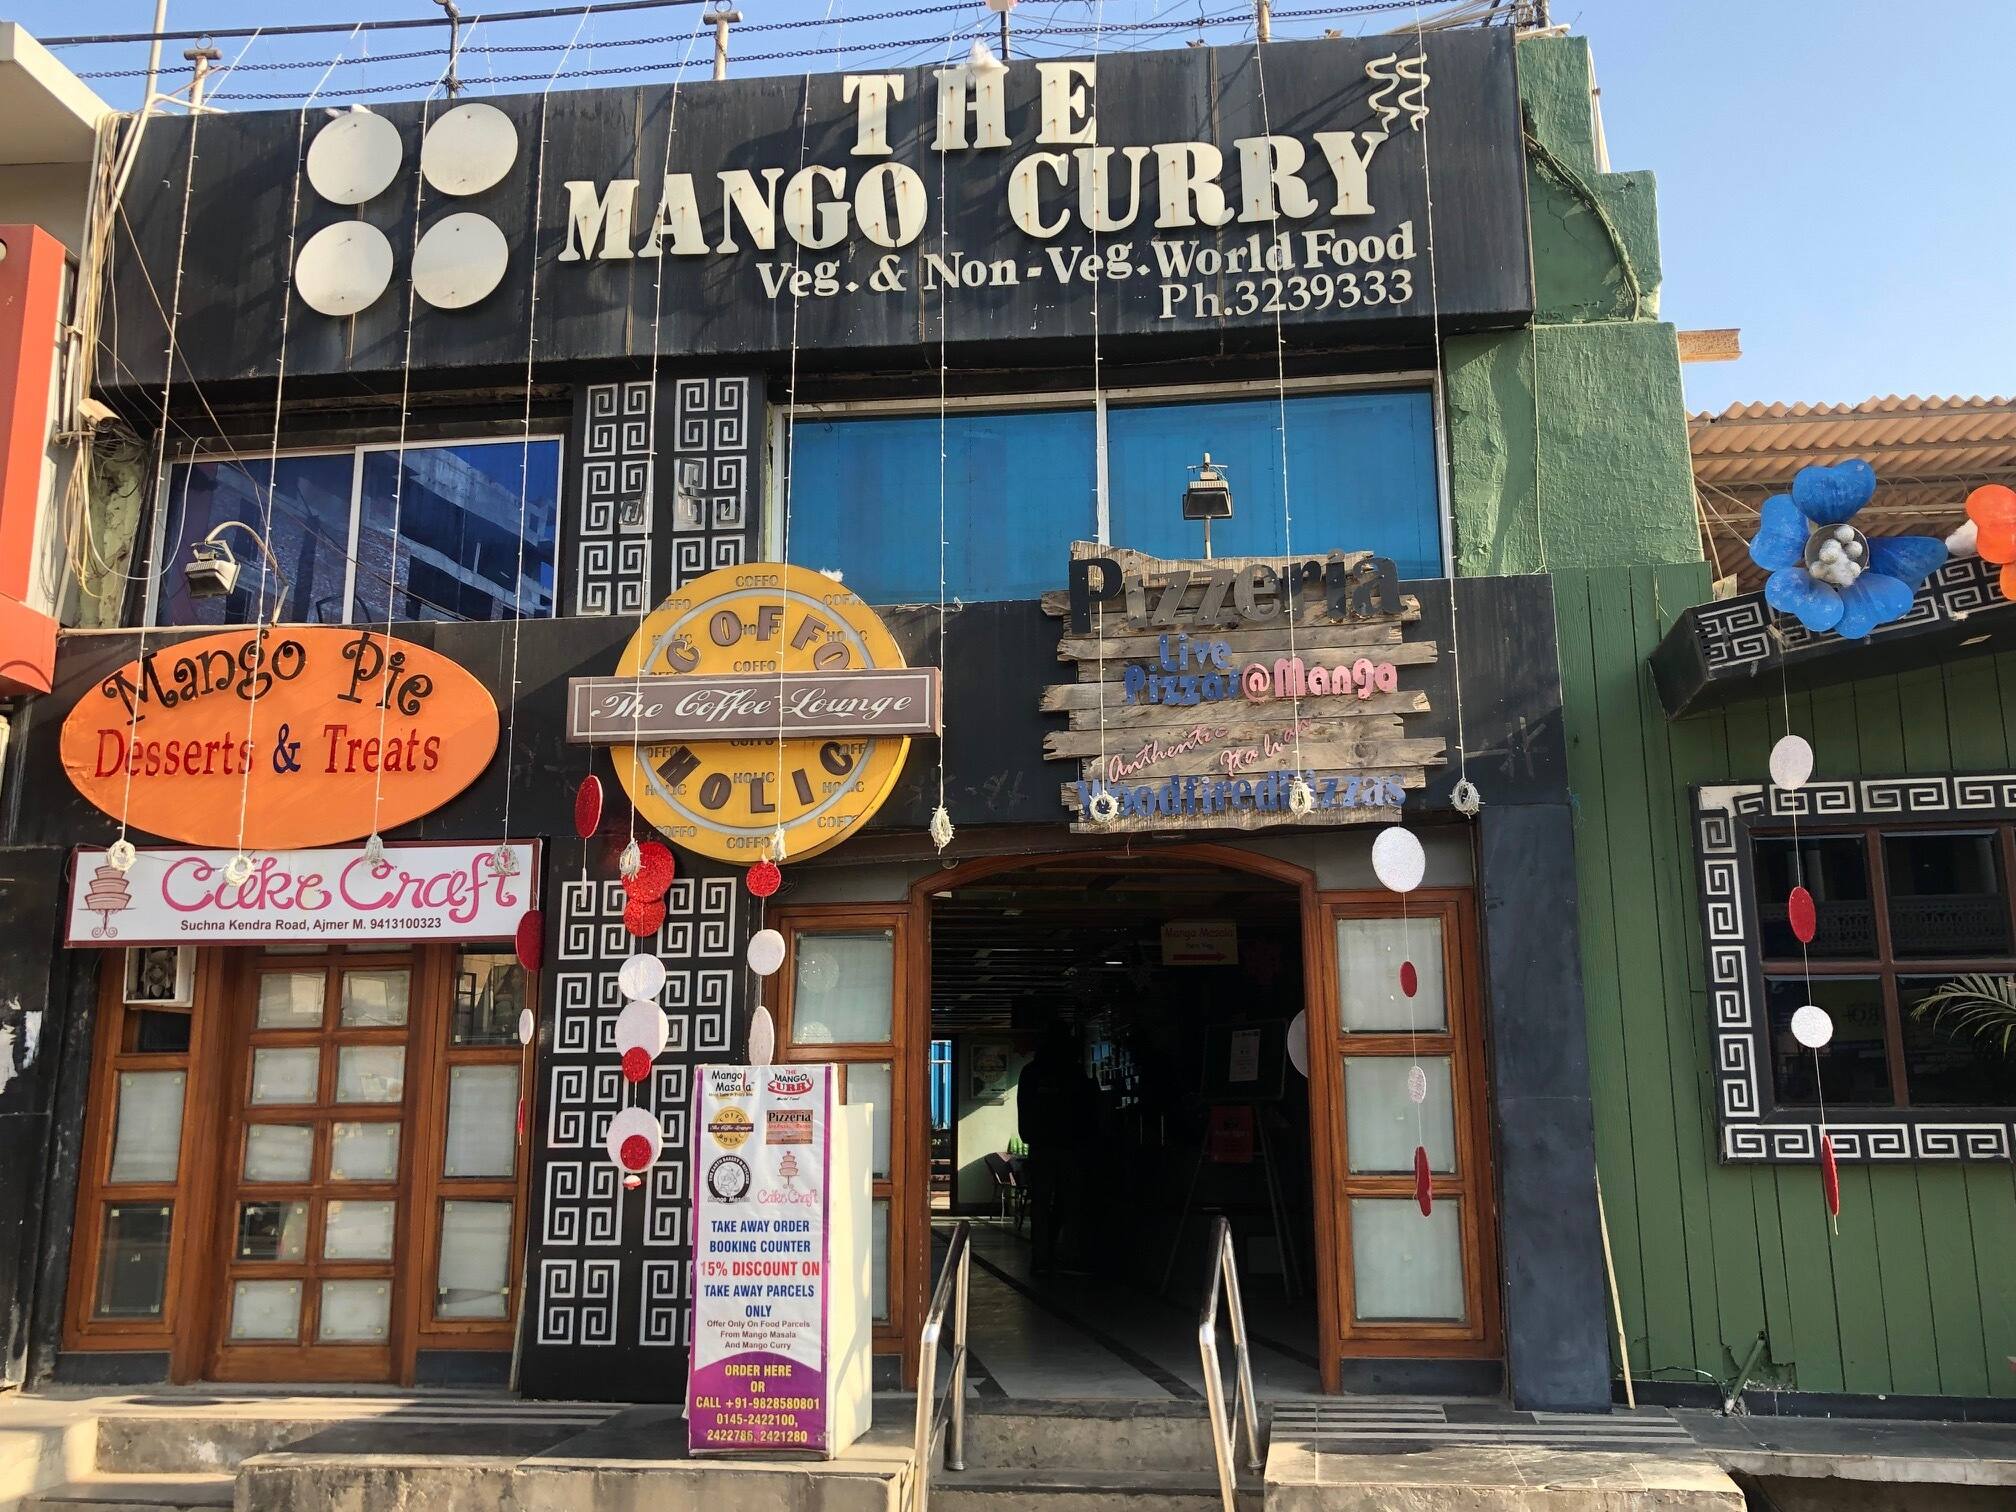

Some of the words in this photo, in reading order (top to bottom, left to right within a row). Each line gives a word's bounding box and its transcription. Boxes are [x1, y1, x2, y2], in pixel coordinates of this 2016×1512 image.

[842, 61, 1098, 156] THE
[558, 161, 929, 262] MANGO
[1007, 131, 1388, 239] CURRY
[756, 260, 859, 298] Veg.
[869, 254, 907, 292] &
[1151, 232, 1296, 278] World
[1302, 220, 1416, 269] Food
[1159, 269, 1413, 319] Ph.3239333
[1069, 549, 1407, 634] Pizzeria
[666, 605, 850, 673] COFFO
[1158, 632, 1233, 672] Live
[102, 630, 306, 725] Mango
[337, 632, 433, 716] Pie
[592, 691, 664, 719] The
[675, 688, 772, 723] Coffee
[778, 687, 912, 719] Lounge
[95, 728, 253, 778] Desserts
[273, 723, 301, 774] &
[323, 724, 440, 774] Treats
[656, 741, 854, 814] HOLIC
[162, 856, 332, 912] Cake
[339, 852, 520, 924] Craft
[180, 919, 225, 931] Suchna
[229, 919, 272, 931] Kendra
[275, 919, 310, 932] Road,
[313, 918, 350, 932] Ajmer
[352, 918, 367, 930] M.
[370, 917, 442, 929] 9413100323
[711, 1070, 743, 1082] Mango
[774, 1073, 807, 1083] MANGO
[768, 1112, 811, 1122] Pizzeria
[711, 1220, 737, 1233] TAKE
[740, 1220, 770, 1232] AWAY
[773, 1220, 810, 1232] ORDER
[709, 1240, 757, 1253] BOOKING
[760, 1240, 811, 1252] COUNTER
[701, 1261, 728, 1276] 15%
[732, 1261, 798, 1276] DISCOUNT
[802, 1261, 820, 1276] ON
[704, 1284, 730, 1297] TAKE
[733, 1284, 763, 1297] AWAY
[766, 1284, 815, 1297] PARCELS
[745, 1304, 772, 1317] ONLY
[706, 1320, 726, 1328] Offer
[727, 1320, 746, 1329] Only
[747, 1320, 759, 1328] On
[760, 1320, 780, 1328] Food
[781, 1320, 811, 1328] Parcels
[720, 1330, 740, 1338] From
[741, 1330, 768, 1340] Mango
[769, 1330, 797, 1338] Masala
[724, 1341, 741, 1349] And
[742, 1341, 768, 1350] Mango
[769, 1341, 792, 1350] Curry
[724, 1364, 761, 1377] ORDER
[763, 1364, 793, 1377] HERE
[750, 1380, 766, 1393] OR
[696, 1396, 722, 1408] CALL
[716, 1413, 799, 1428] 0145-2422100,
[760, 1430, 808, 1443] 2421280
